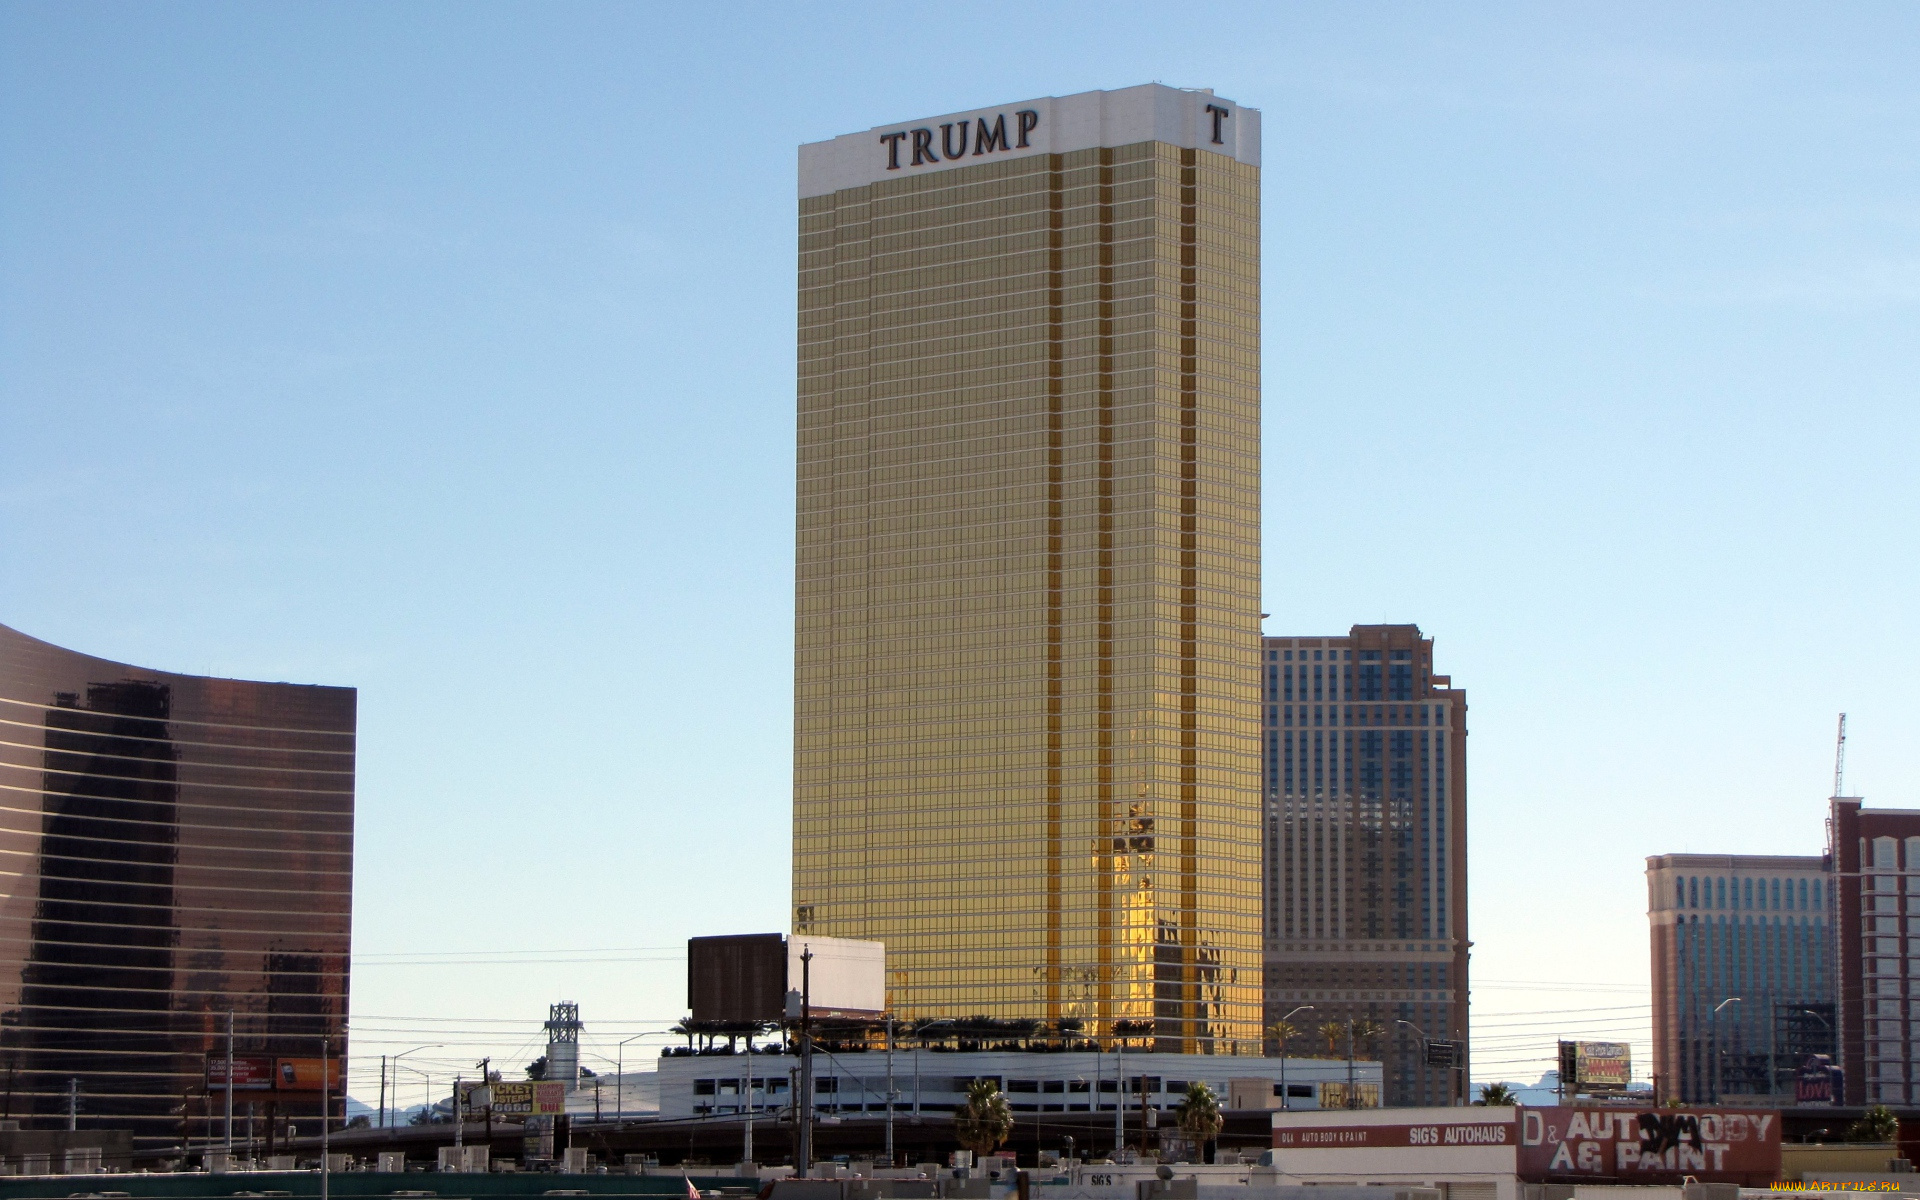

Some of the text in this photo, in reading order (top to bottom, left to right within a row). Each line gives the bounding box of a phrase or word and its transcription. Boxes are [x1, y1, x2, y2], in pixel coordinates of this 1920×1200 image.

[1206, 104, 1229, 145] T
[879, 109, 1038, 170] TRUMP
[491, 1083, 531, 1095] ICKET
[493, 1093, 531, 1103] USTERS
[1301, 1132, 1319, 1142] AUTO
[1320, 1132, 1337, 1142] BODY
[1345, 1131, 1367, 1141] PAINT
[1409, 1125, 1506, 1144] SIG'S AUTOHAUS
[1617, 1142, 1730, 1171] PAINT
[1091, 1174, 1112, 1186] SIG'S
